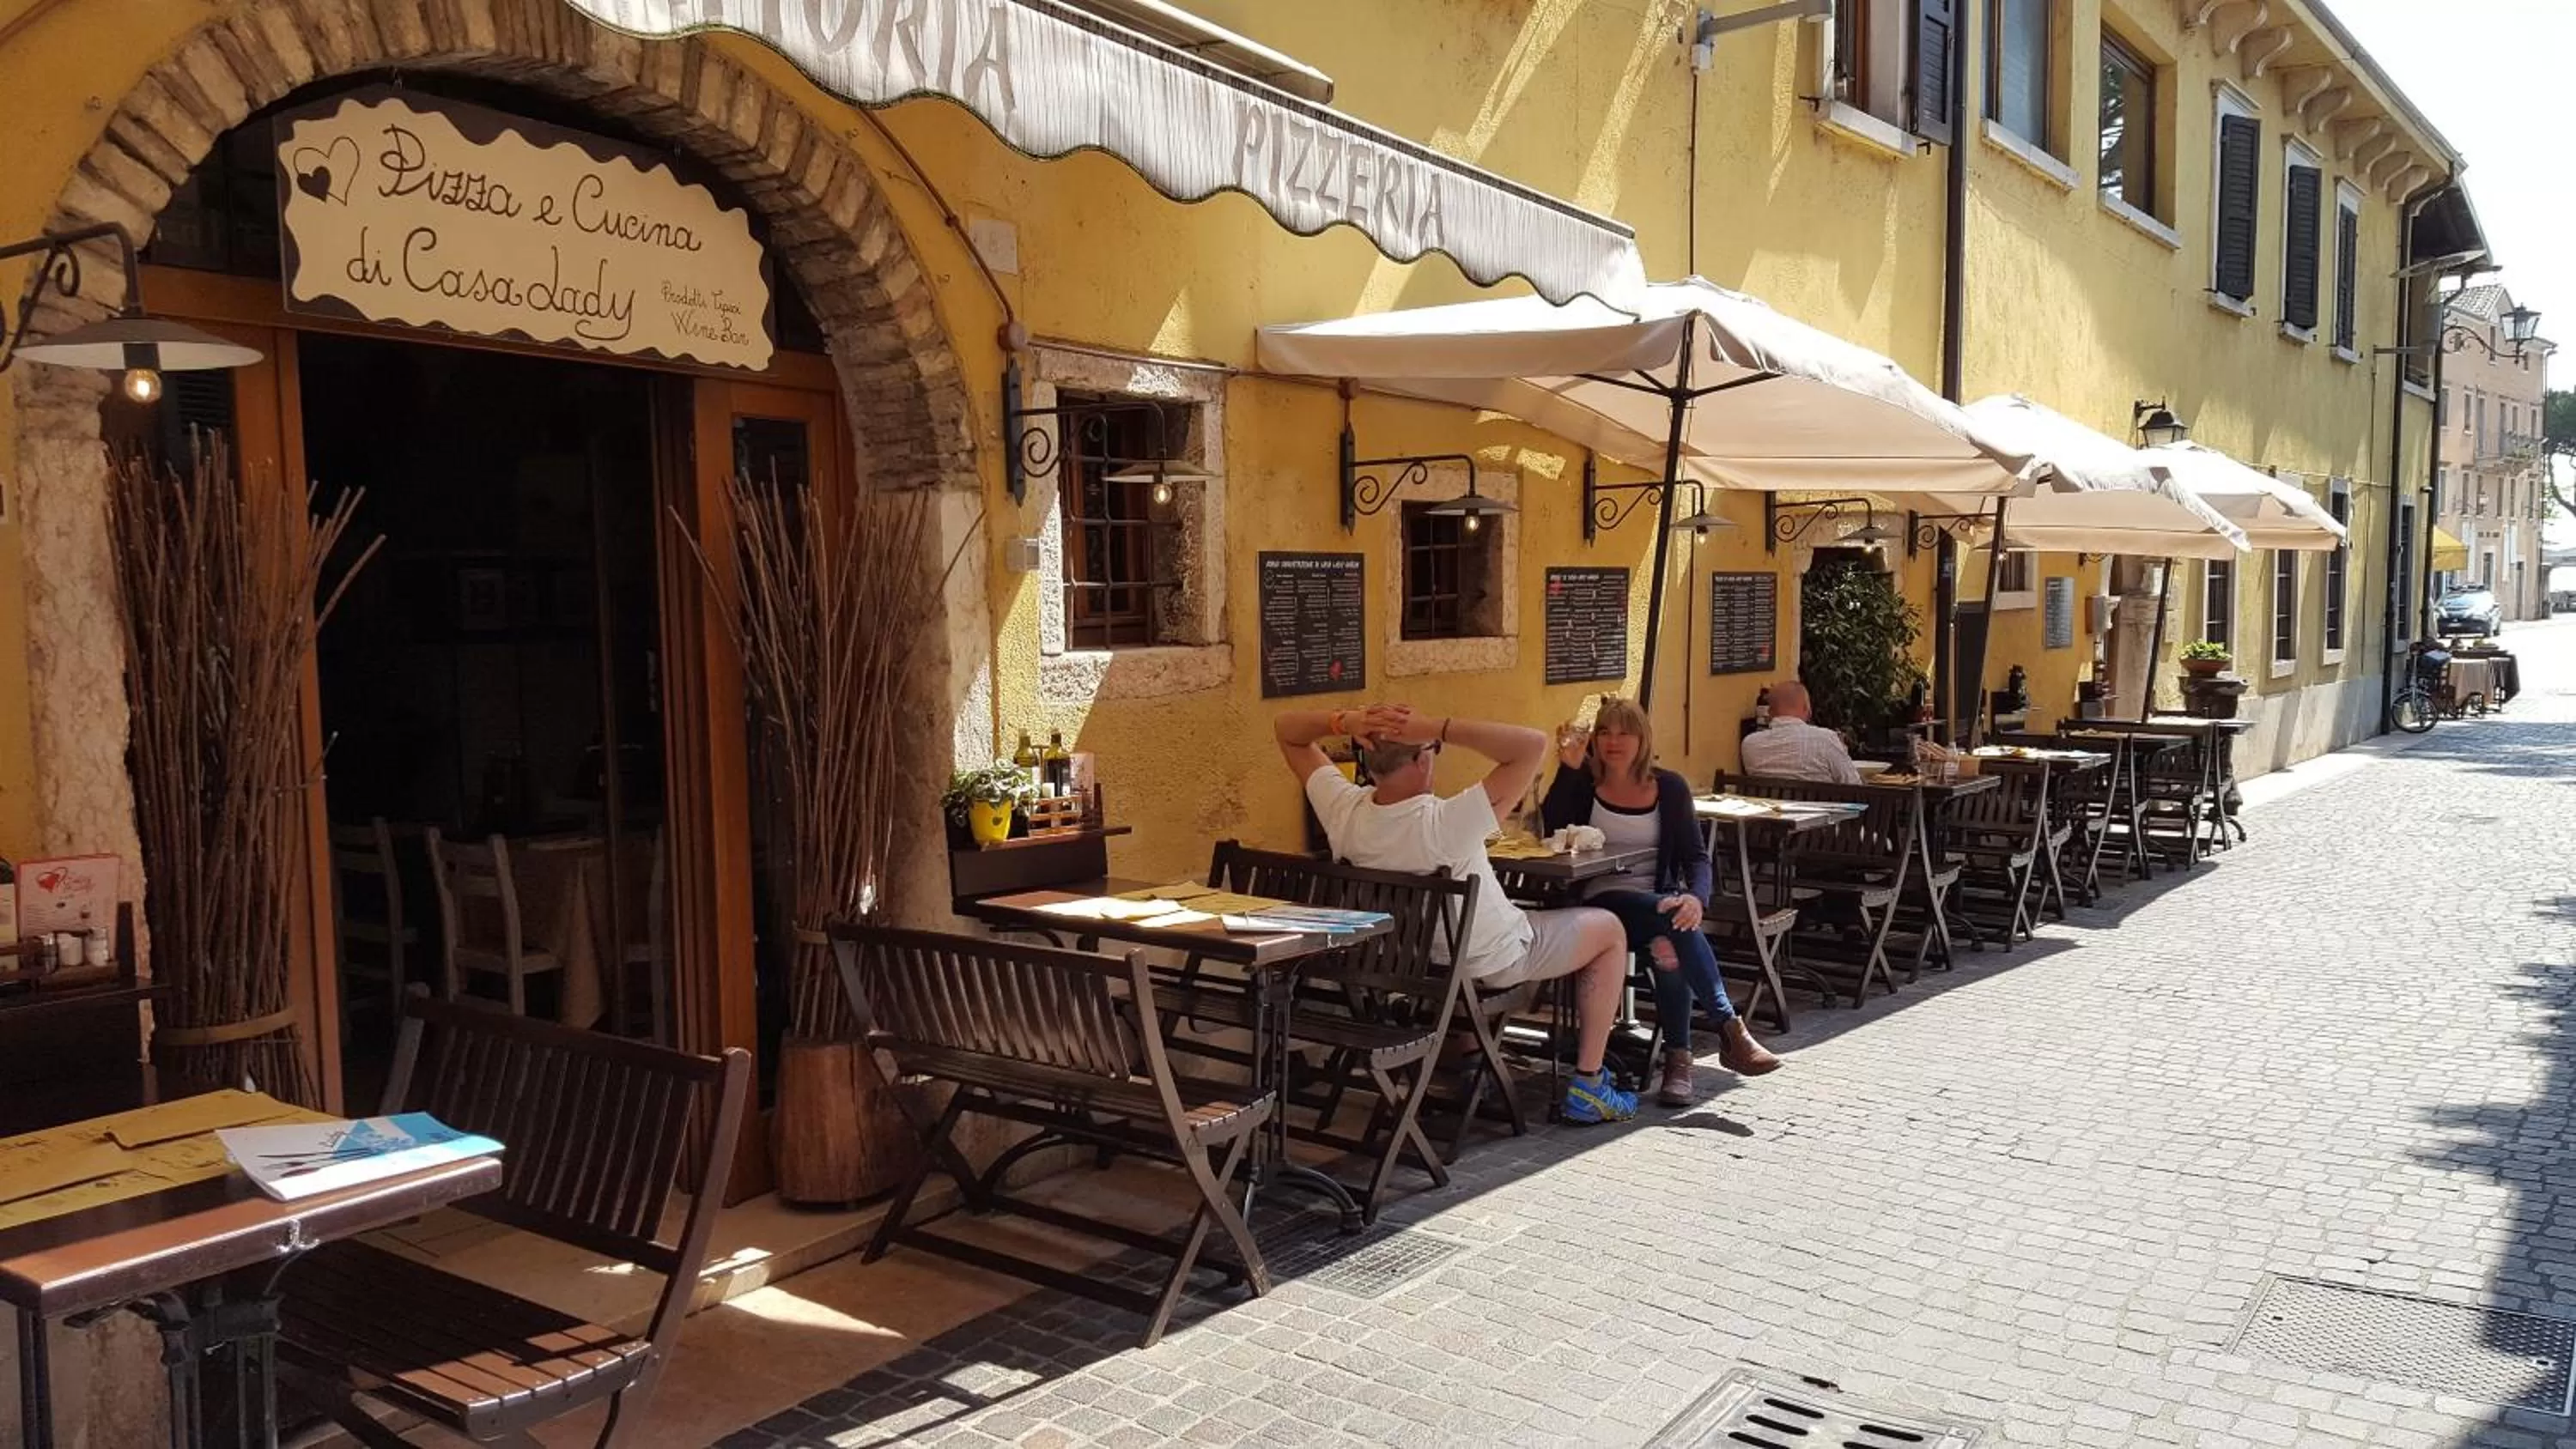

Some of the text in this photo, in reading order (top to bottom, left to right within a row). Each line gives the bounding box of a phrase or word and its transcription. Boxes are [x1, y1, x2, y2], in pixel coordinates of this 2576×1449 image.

[378, 123, 702, 252] Pizza e Cucina
[1232, 100, 1445, 246] PIZZERIA
[346, 226, 392, 286] di
[403, 227, 523, 306] Casa
[670, 308, 719, 341] Wine
